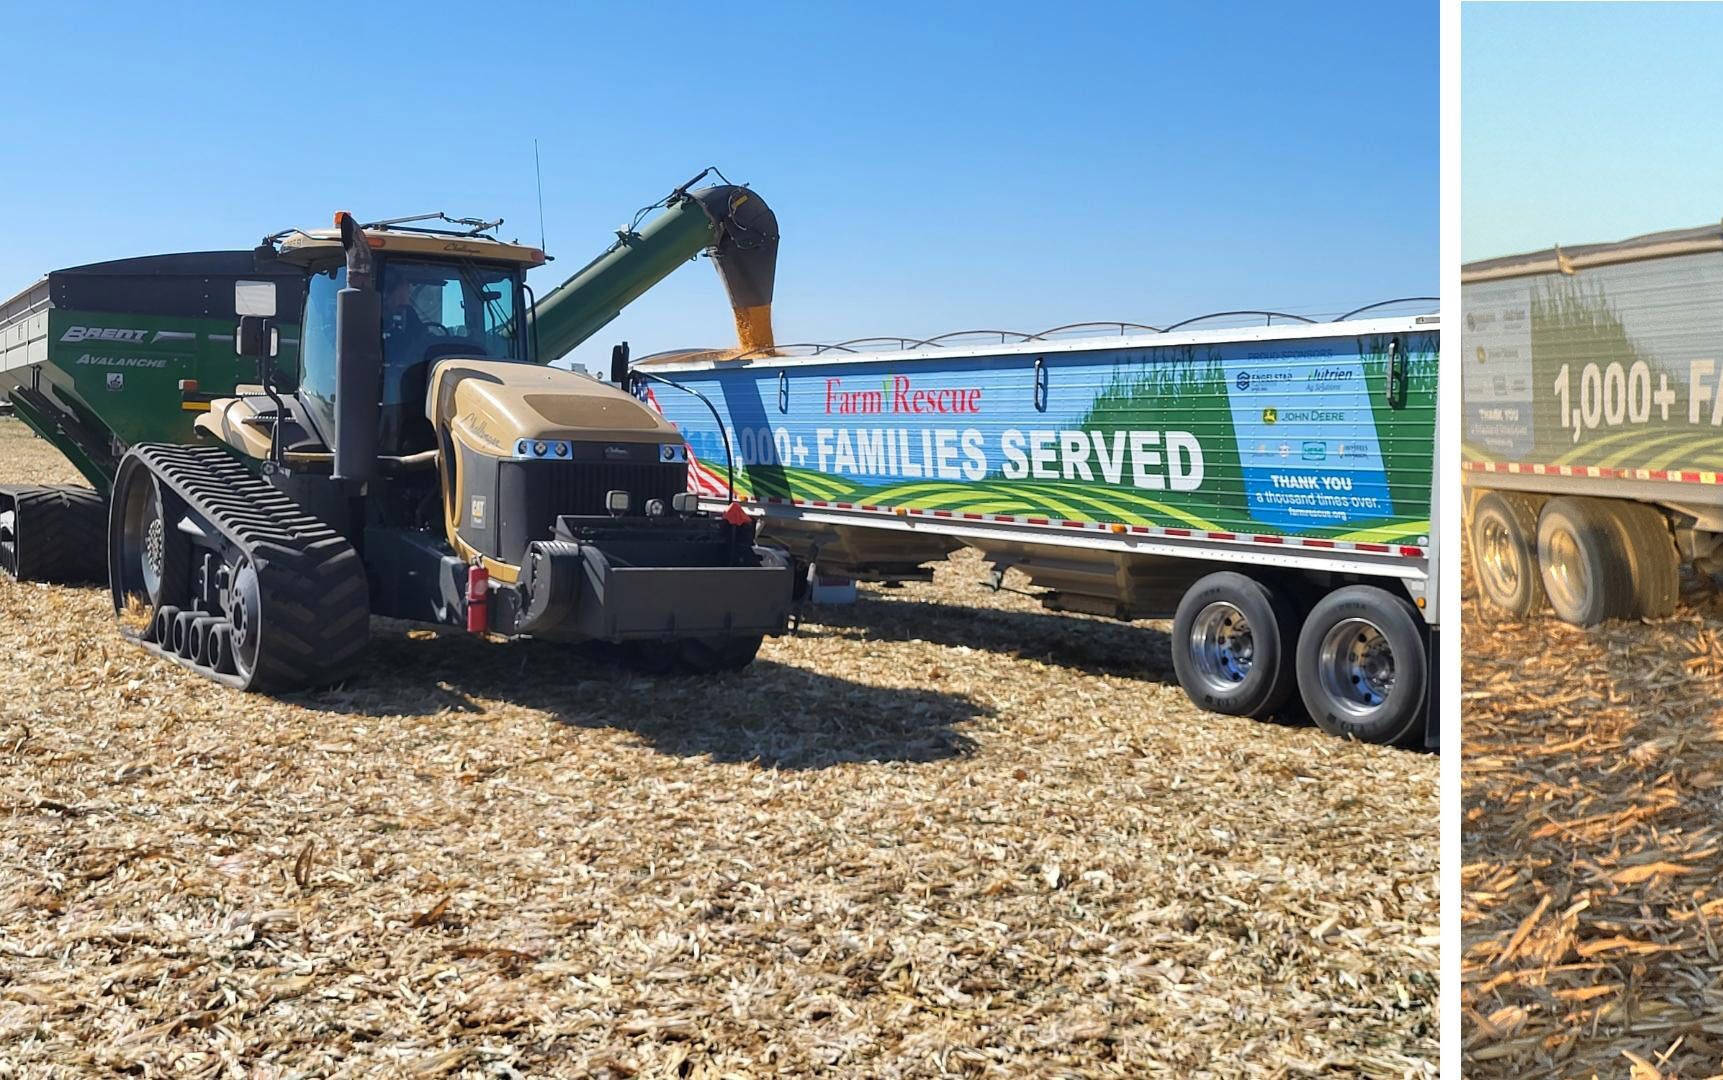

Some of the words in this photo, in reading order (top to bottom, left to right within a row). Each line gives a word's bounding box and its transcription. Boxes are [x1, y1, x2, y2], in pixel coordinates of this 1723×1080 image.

[76, 354, 168, 368] AVALANCHE
[824, 378, 883, 415] Farm
[892, 376, 982, 414] Rescue
[1554, 360, 1676, 444] 1,000+
[1281, 412, 1310, 421] JOHN
[1311, 410, 1345, 422] DEERE
[816, 428, 987, 481] FAMILIES
[1002, 430, 1205, 491] SERVED
[1270, 475, 1320, 490] THANK
[1322, 476, 1352, 491] YOU
[1256, 492, 1264, 503] a
[1265, 490, 1317, 505] thousand
[1317, 492, 1348, 508] times
[1351, 497, 1382, 509] over.
